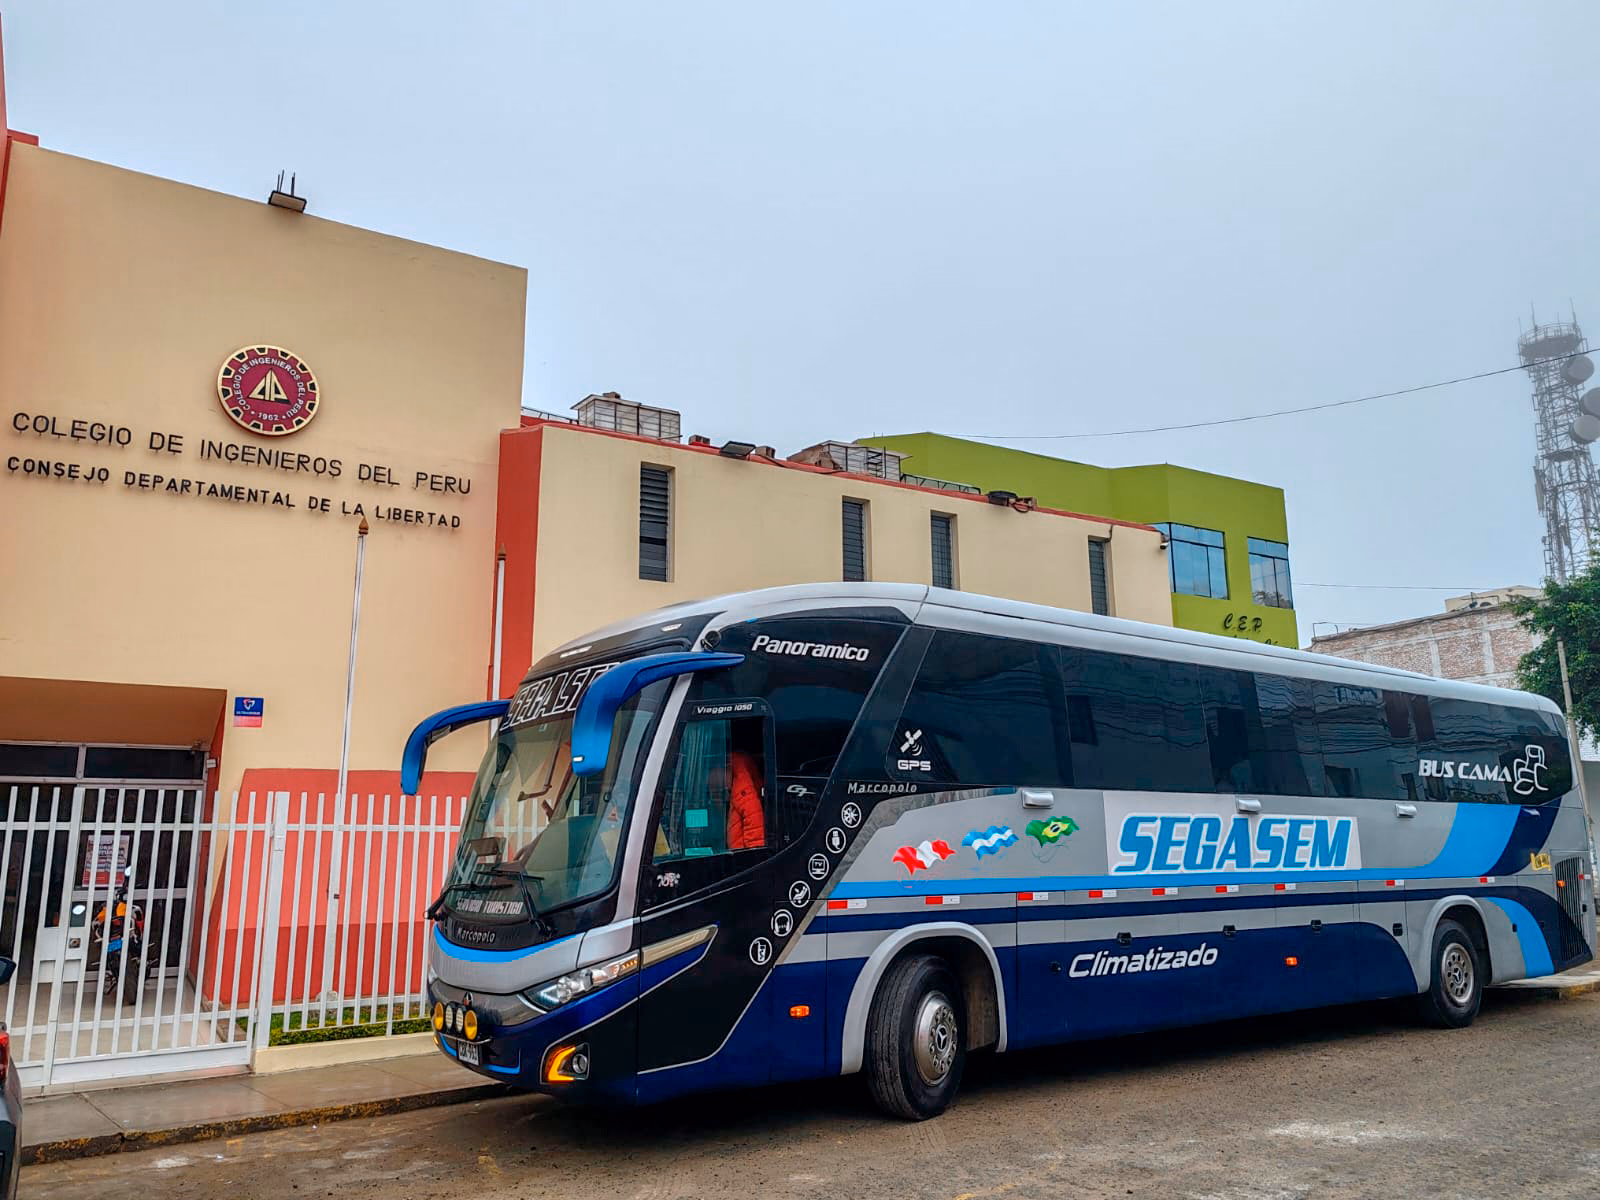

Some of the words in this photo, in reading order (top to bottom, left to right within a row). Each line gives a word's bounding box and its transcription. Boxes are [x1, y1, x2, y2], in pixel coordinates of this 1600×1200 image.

[238, 363, 250, 375] DE
[249, 357, 301, 381] INGENIEROS
[233, 373, 251, 411] COLEGIO
[296, 382, 306, 397] DEL
[286, 398, 304, 418] PERU
[12, 412, 132, 447] COLEGIO
[149, 431, 184, 454] DE
[200, 439, 343, 477] INGENIEROS
[358, 463, 400, 487] DEL
[415, 471, 471, 494] PERU
[7, 456, 109, 483] CONSEJO
[124, 470, 295, 508] DEPARTAMENTAL
[308, 496, 331, 512] DE
[341, 501, 365, 516] LA
[375, 505, 461, 529] LIBERTAD
[751, 635, 870, 661] Panoramico
[697, 705, 733, 714] Viaggio
[897, 760, 931, 771] GPS
[1418, 759, 1454, 778] BUS
[1458, 762, 1512, 782] CAMA
[847, 782, 917, 794] Marcopolo
[1114, 815, 1352, 873] SEGASEM
[457, 927, 496, 943] Marcopolo
[1069, 942, 1218, 978] Climatizado
